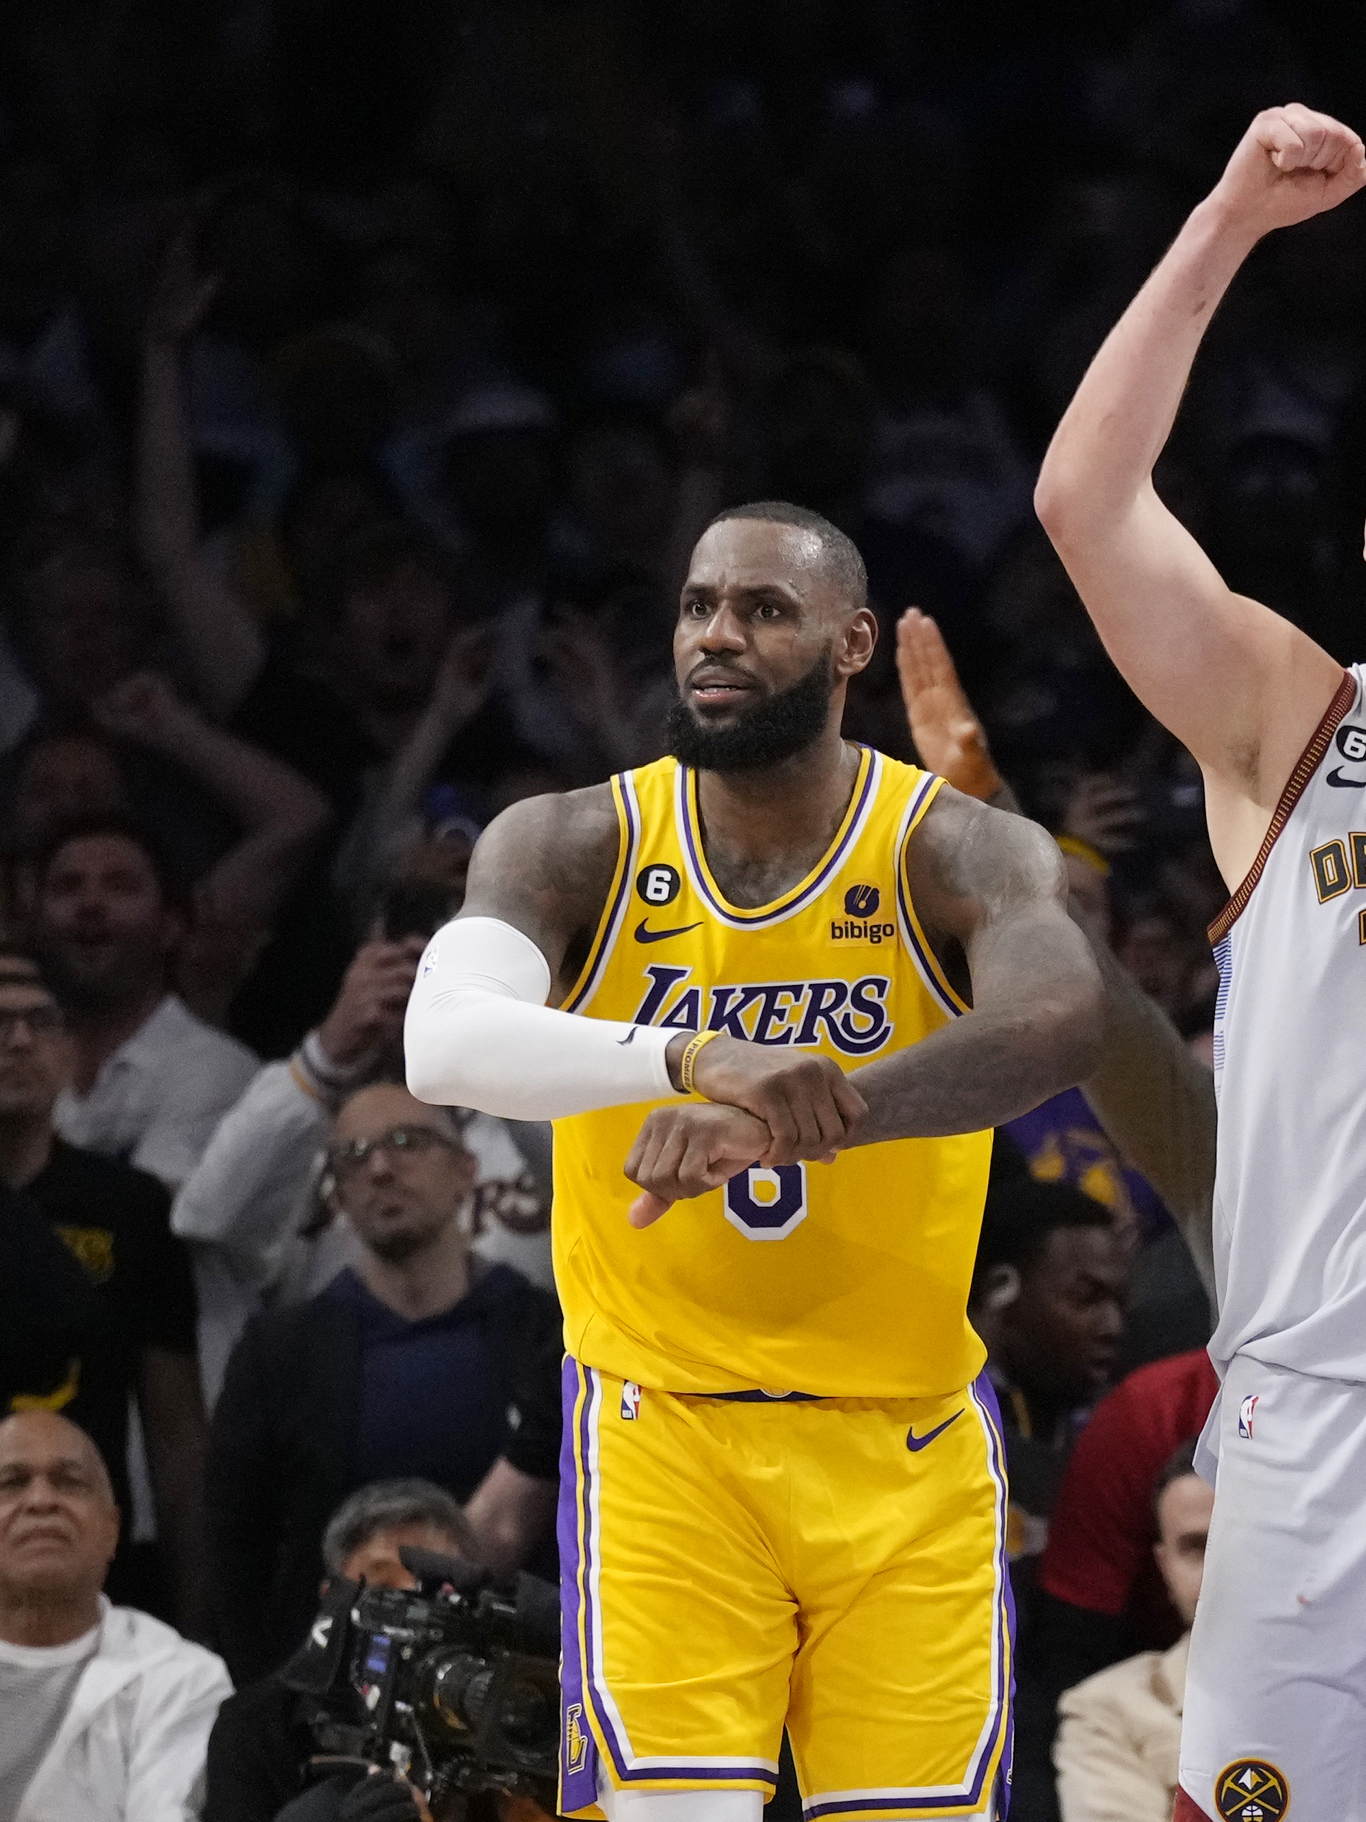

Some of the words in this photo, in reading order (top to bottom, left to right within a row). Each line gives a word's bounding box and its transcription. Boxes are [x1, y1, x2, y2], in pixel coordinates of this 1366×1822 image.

[646, 869, 671, 902] 6
[831, 921, 895, 944] bibigo
[633, 963, 895, 1058] LAKERS
